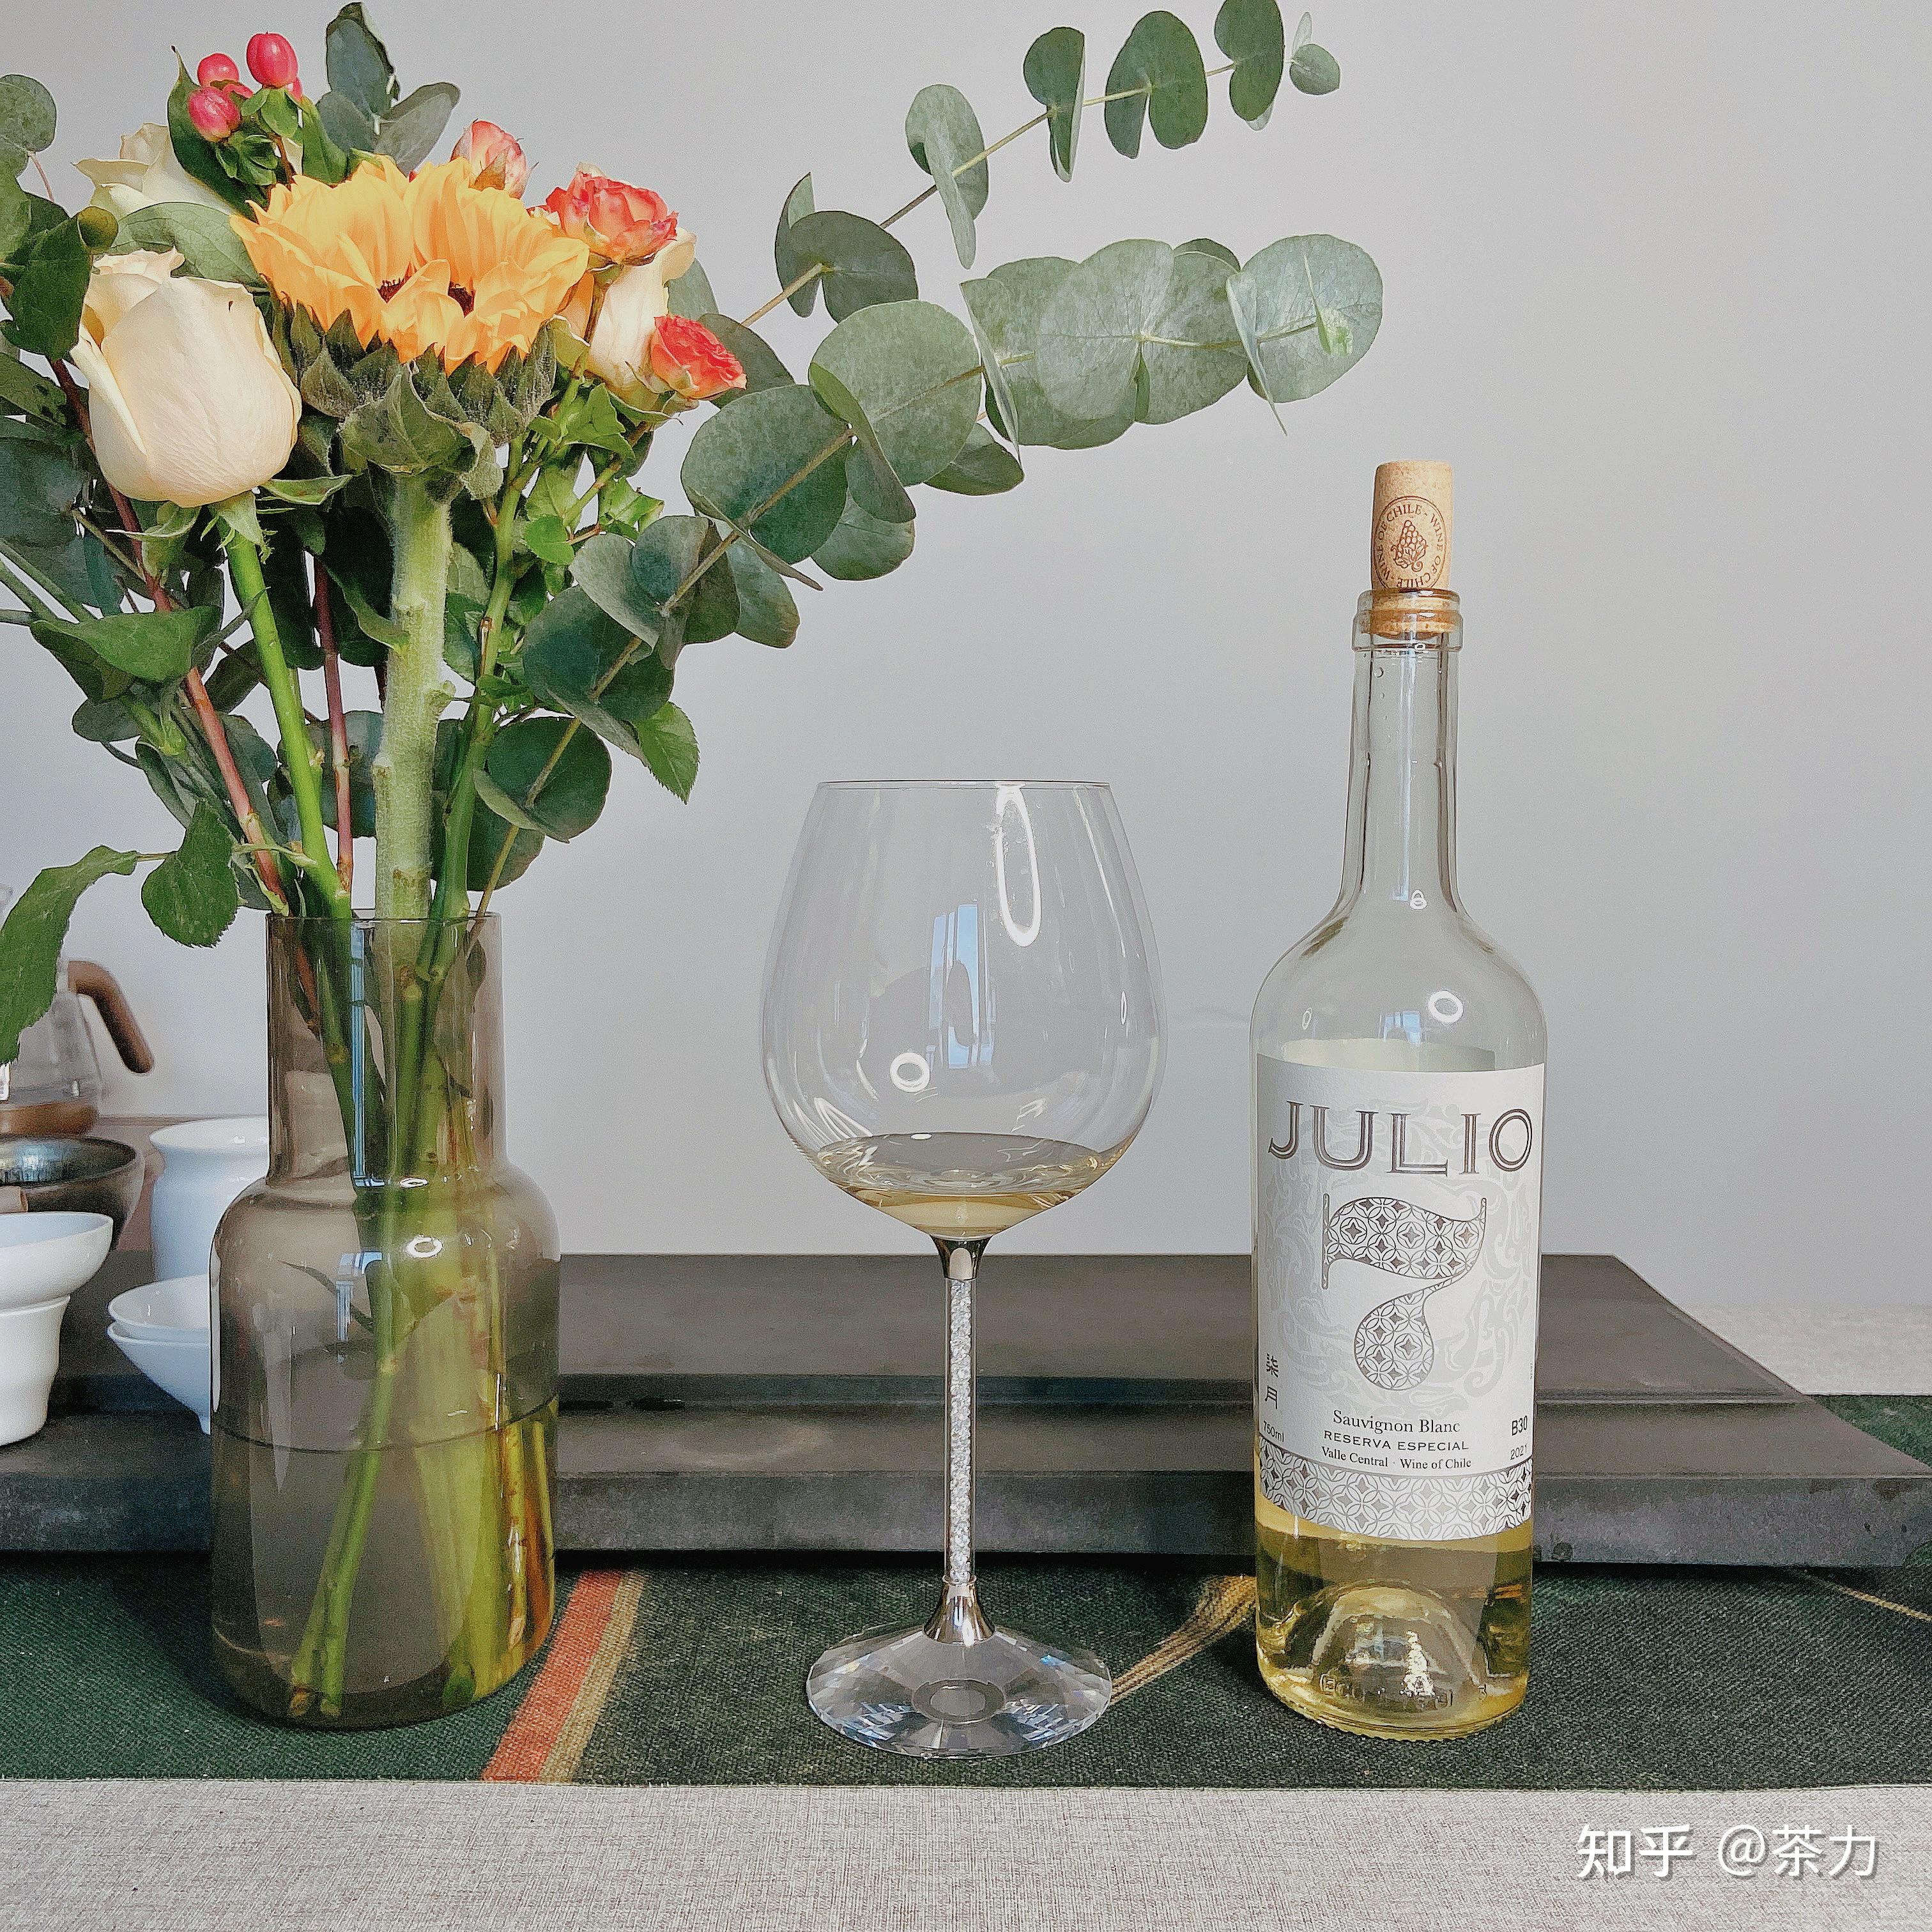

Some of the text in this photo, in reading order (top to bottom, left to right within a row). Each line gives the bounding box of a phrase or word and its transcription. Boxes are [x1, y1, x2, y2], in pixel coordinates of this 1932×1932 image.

[1377, 503, 1422, 580] WINE OF CHILE
[1397, 513, 1443, 588] WINE OF CHILE
[1268, 1100, 1533, 1176] JULIO
[1321, 1192, 1487, 1391] 7
[1265, 1353, 1280, 1409] 柒月
[1263, 1420, 1284, 1442] 750ml
[1333, 1409, 1460, 1434] Sauvignon Blanc
[1512, 1415, 1528, 1436] B30
[1324, 1430, 1469, 1452] RESERVA ESPECIAL
[1510, 1444, 1528, 1460] 2021
[1321, 1446, 1472, 1469] Valle Central Wine of Chile
